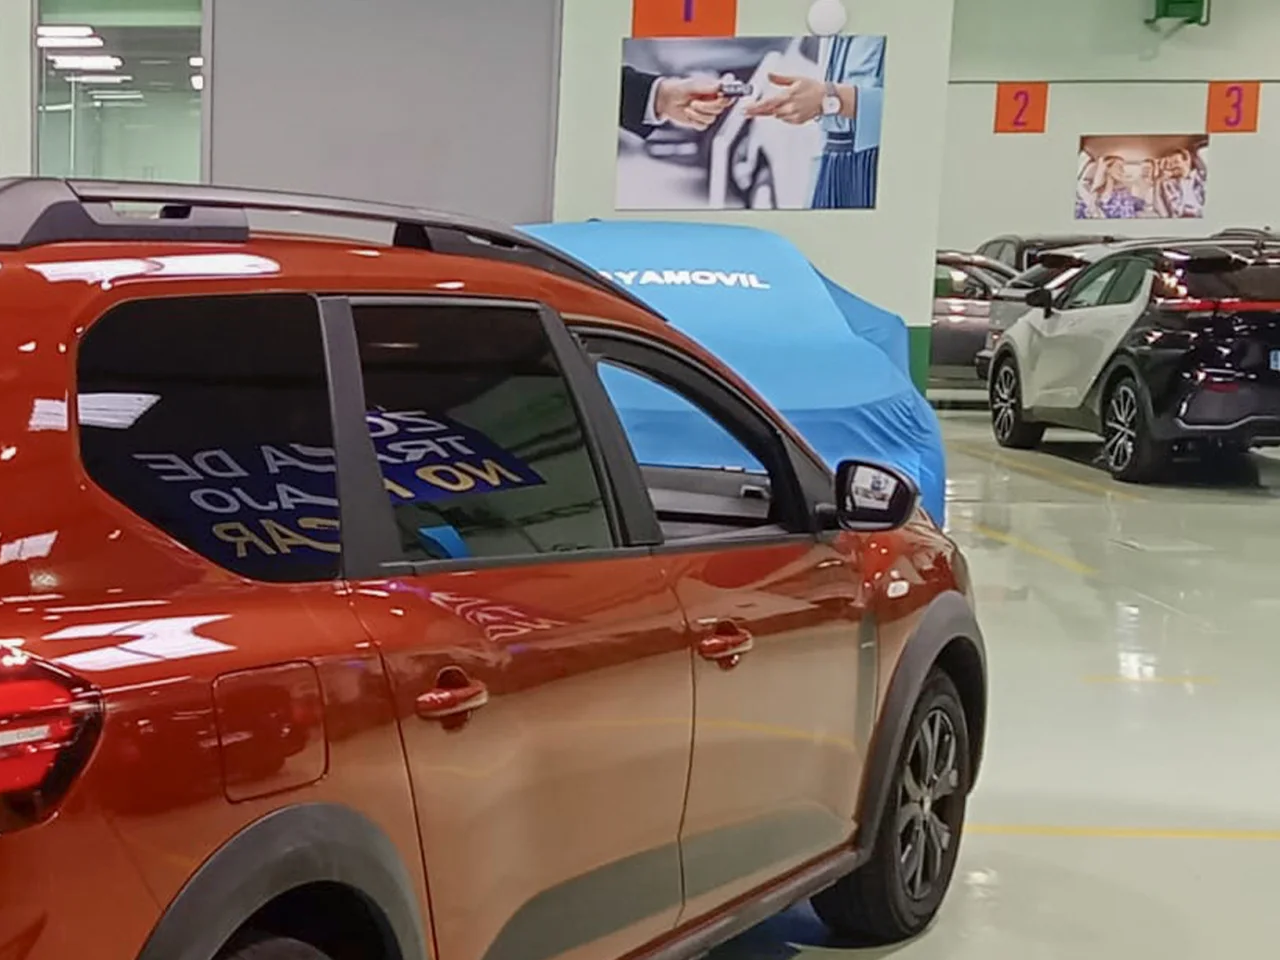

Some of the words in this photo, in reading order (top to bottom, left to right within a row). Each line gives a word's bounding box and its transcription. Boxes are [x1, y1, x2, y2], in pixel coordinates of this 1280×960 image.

[1012, 90, 1030, 126] 2
[1224, 85, 1243, 127] 3
[614, 270, 771, 289] YAMOVIL
